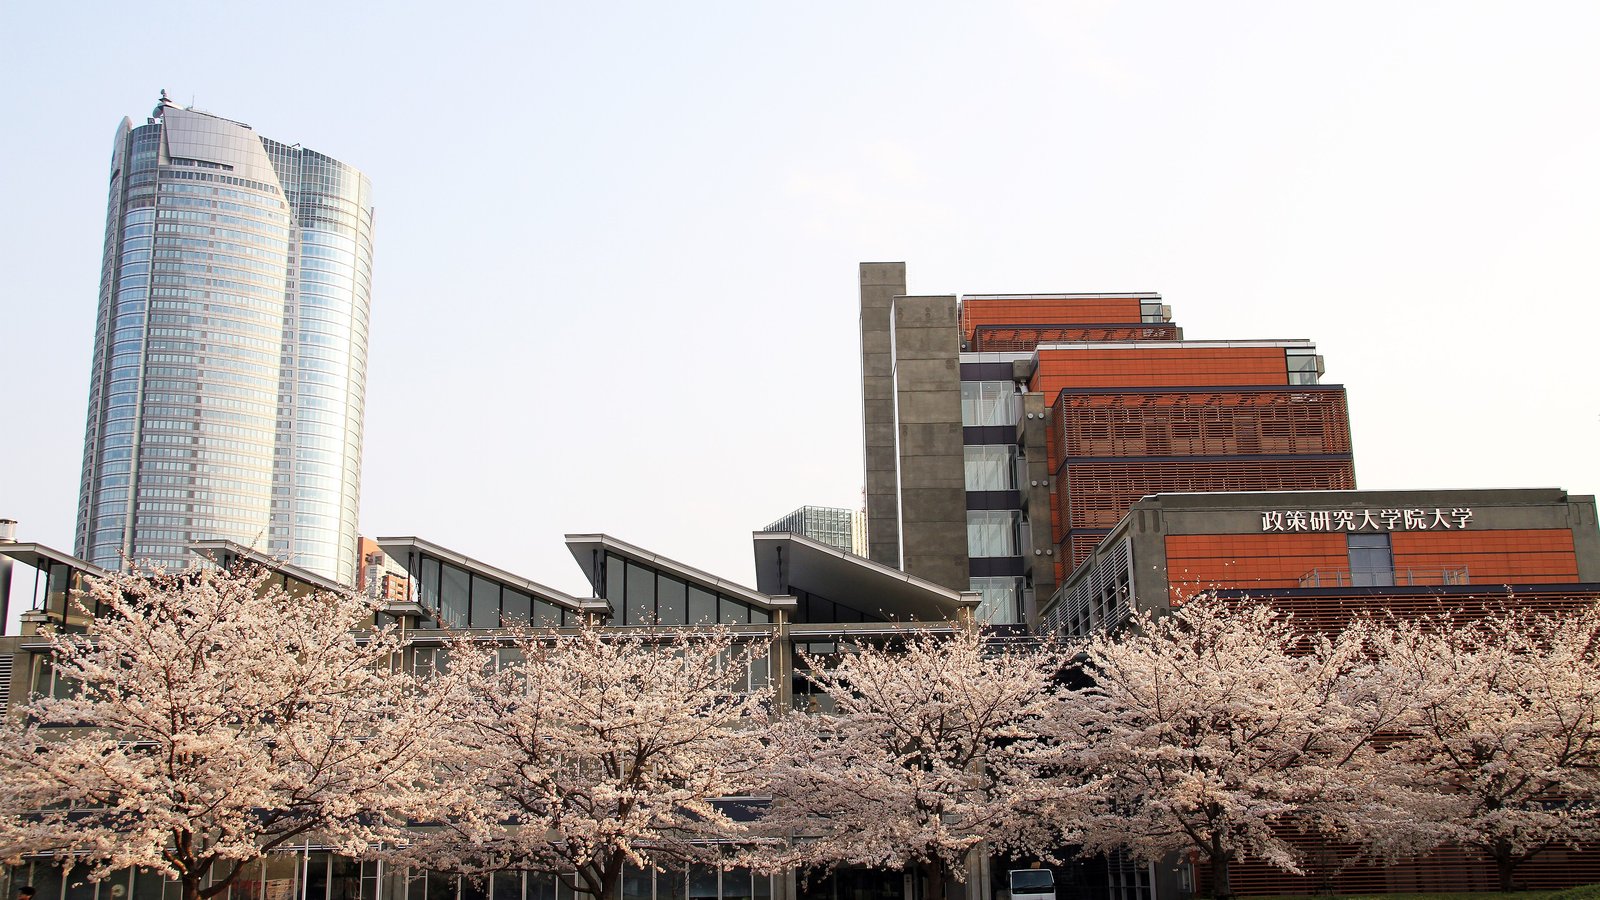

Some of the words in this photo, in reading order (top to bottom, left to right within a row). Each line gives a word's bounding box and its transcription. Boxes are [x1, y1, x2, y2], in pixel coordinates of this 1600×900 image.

[1261, 508, 1473, 531] 政策研究大学院大学
